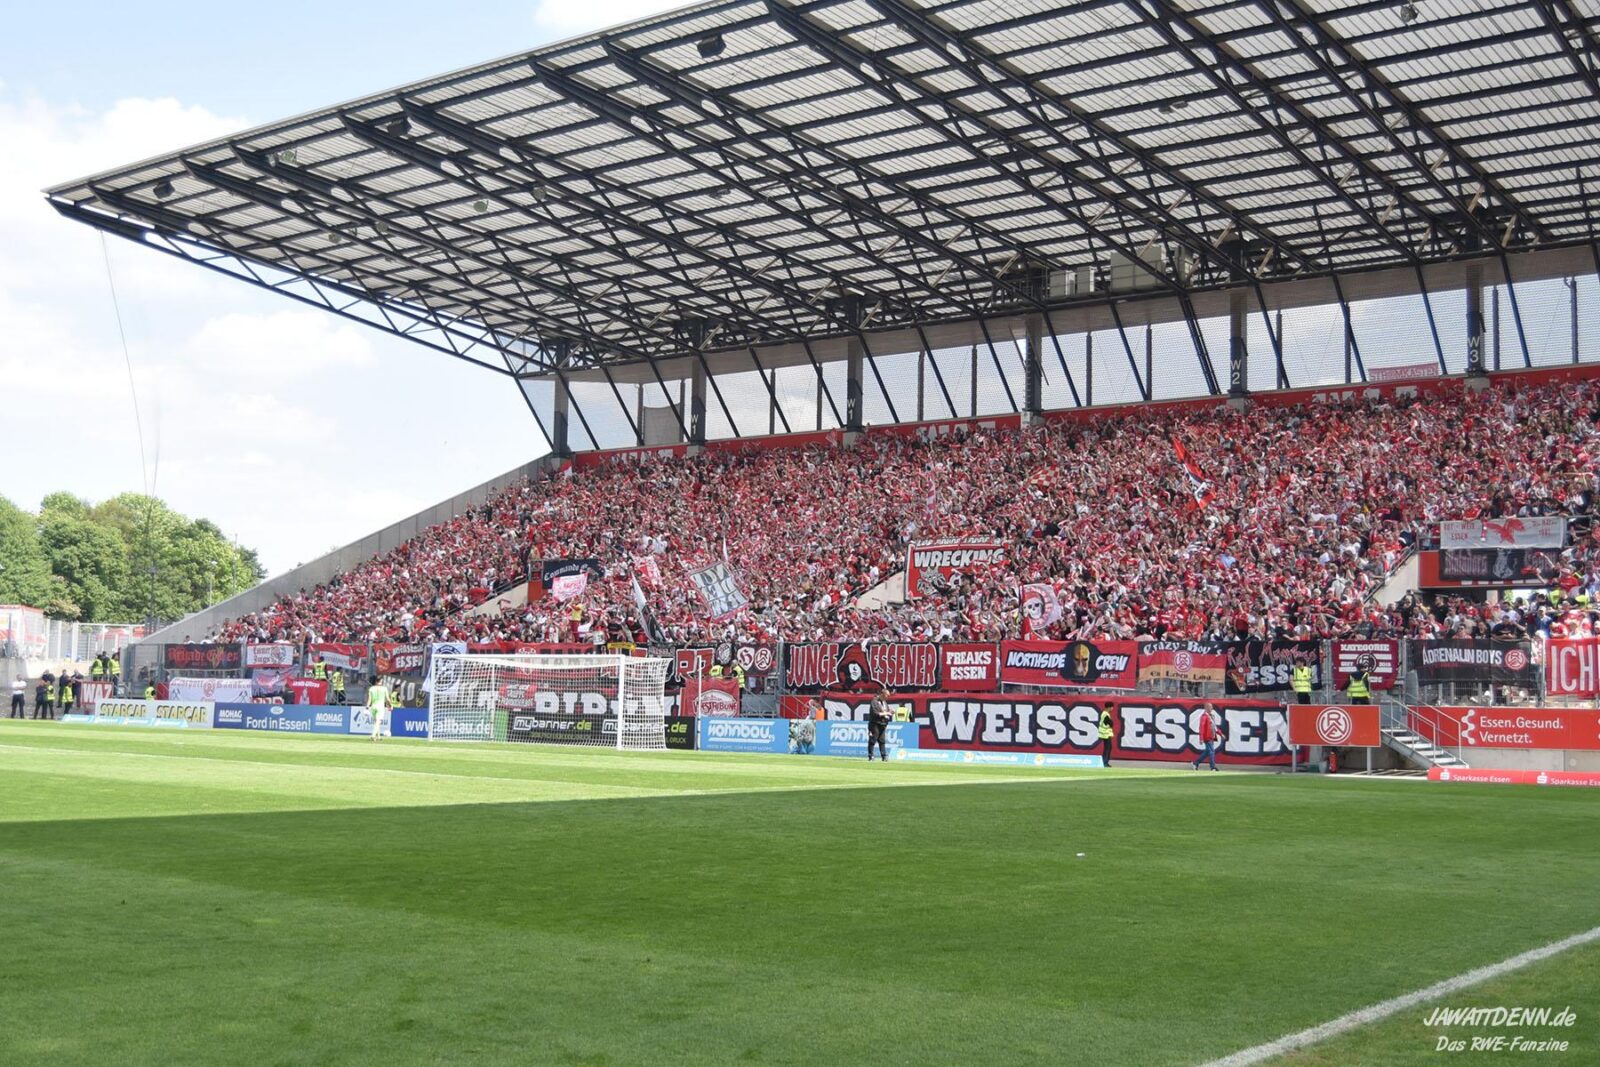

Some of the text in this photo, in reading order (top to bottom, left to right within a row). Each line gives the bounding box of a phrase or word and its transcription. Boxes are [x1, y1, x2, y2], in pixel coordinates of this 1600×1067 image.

[914, 549, 1004, 567] WRECKING
[946, 652, 991, 665] FREAKS
[1007, 652, 1128, 671] NORTHSIDE CREW
[1423, 646, 1502, 665] ADRENALIN BOYS
[787, 643, 937, 687] JUNGE ESSENER
[1551, 645, 1593, 692] ICH
[951, 666, 986, 680] ESSEN
[83, 683, 112, 704] WAZ
[100, 703, 147, 718] STARCAR
[156, 704, 207, 722] STARCAR
[219, 709, 242, 719] MOHAG
[315, 713, 343, 722] MOHAG
[246, 717, 311, 731] Ford in Essen!
[1480, 731, 1532, 743] Vernetzt.
[1452, 774, 1488, 782] Sparkasse
[1550, 778, 1587, 786] Sparkasse
